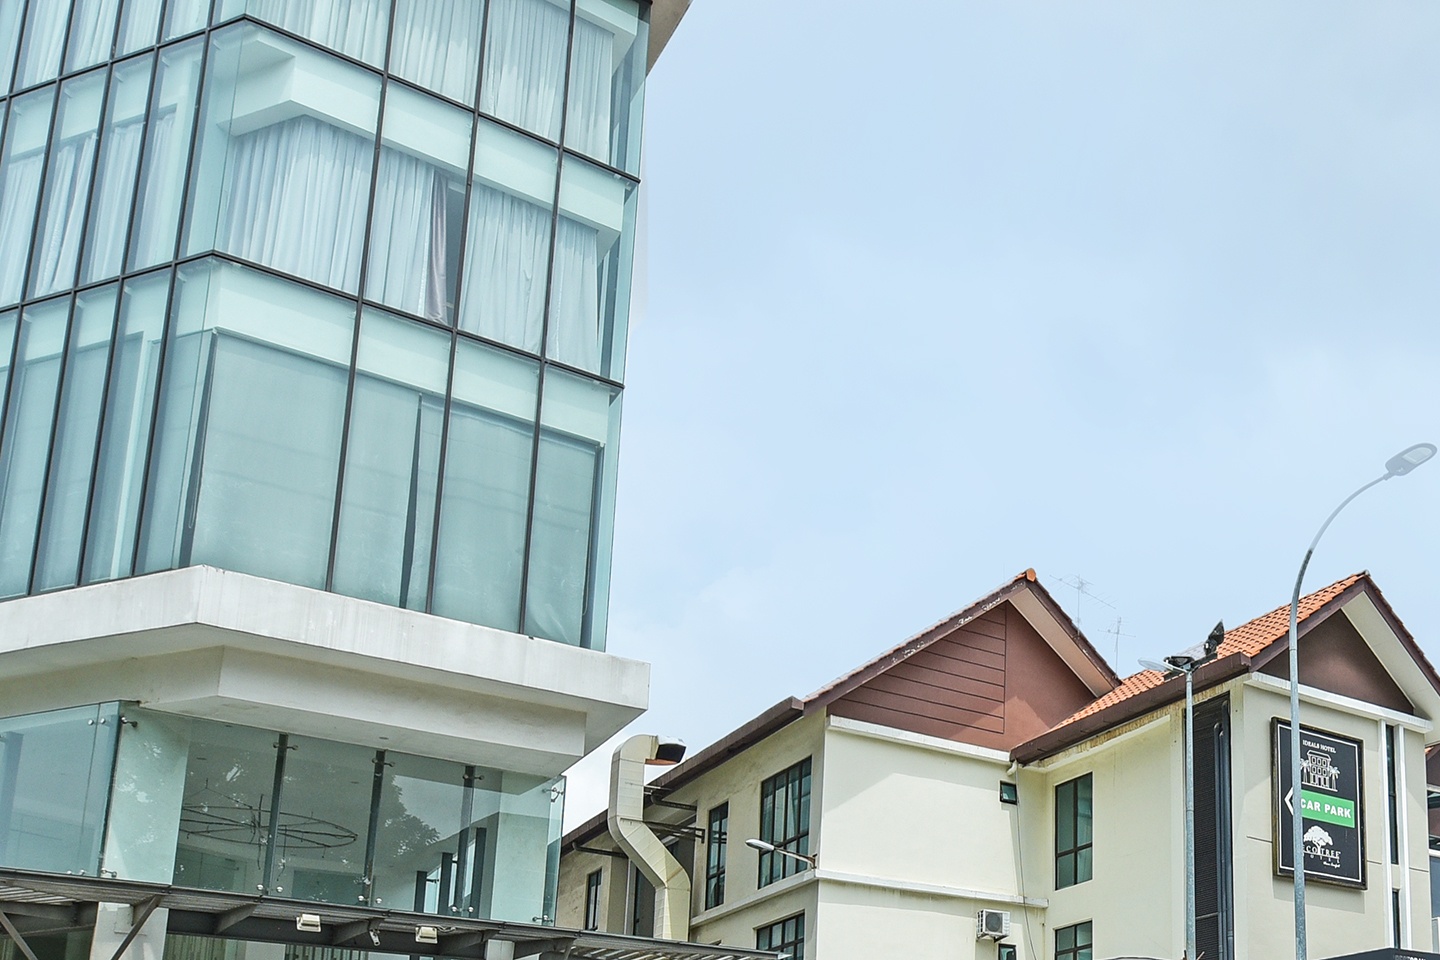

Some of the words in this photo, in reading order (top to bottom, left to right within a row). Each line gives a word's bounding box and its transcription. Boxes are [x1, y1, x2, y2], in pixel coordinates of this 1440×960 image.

[1302, 739, 1320, 749] IDEALS
[1320, 743, 1337, 754] HOTEL
[1300, 798, 1321, 812] CAR
[1324, 803, 1352, 819] PARK
